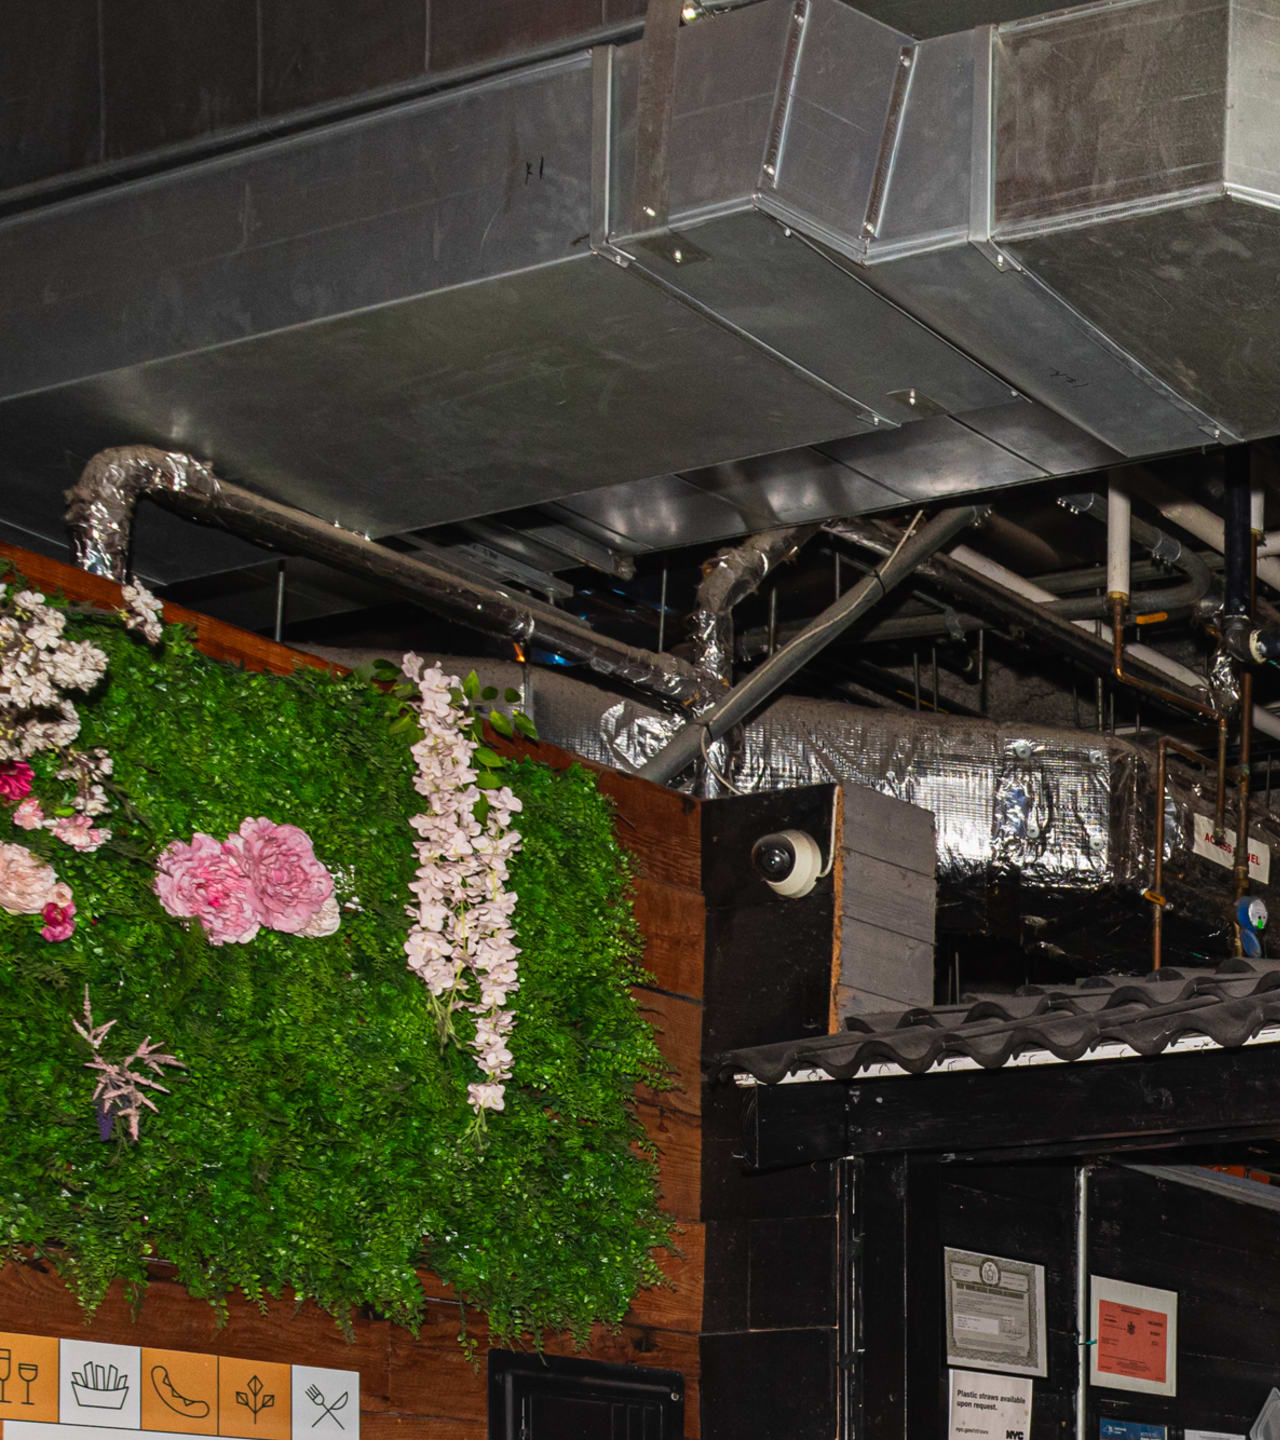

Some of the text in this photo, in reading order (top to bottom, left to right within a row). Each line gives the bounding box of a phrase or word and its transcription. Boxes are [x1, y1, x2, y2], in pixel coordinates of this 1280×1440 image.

[957, 1389, 1026, 1405] Plastic straws available
[956, 1401, 998, 1412] upon request.
[1006, 1429, 1024, 1440] NYC
